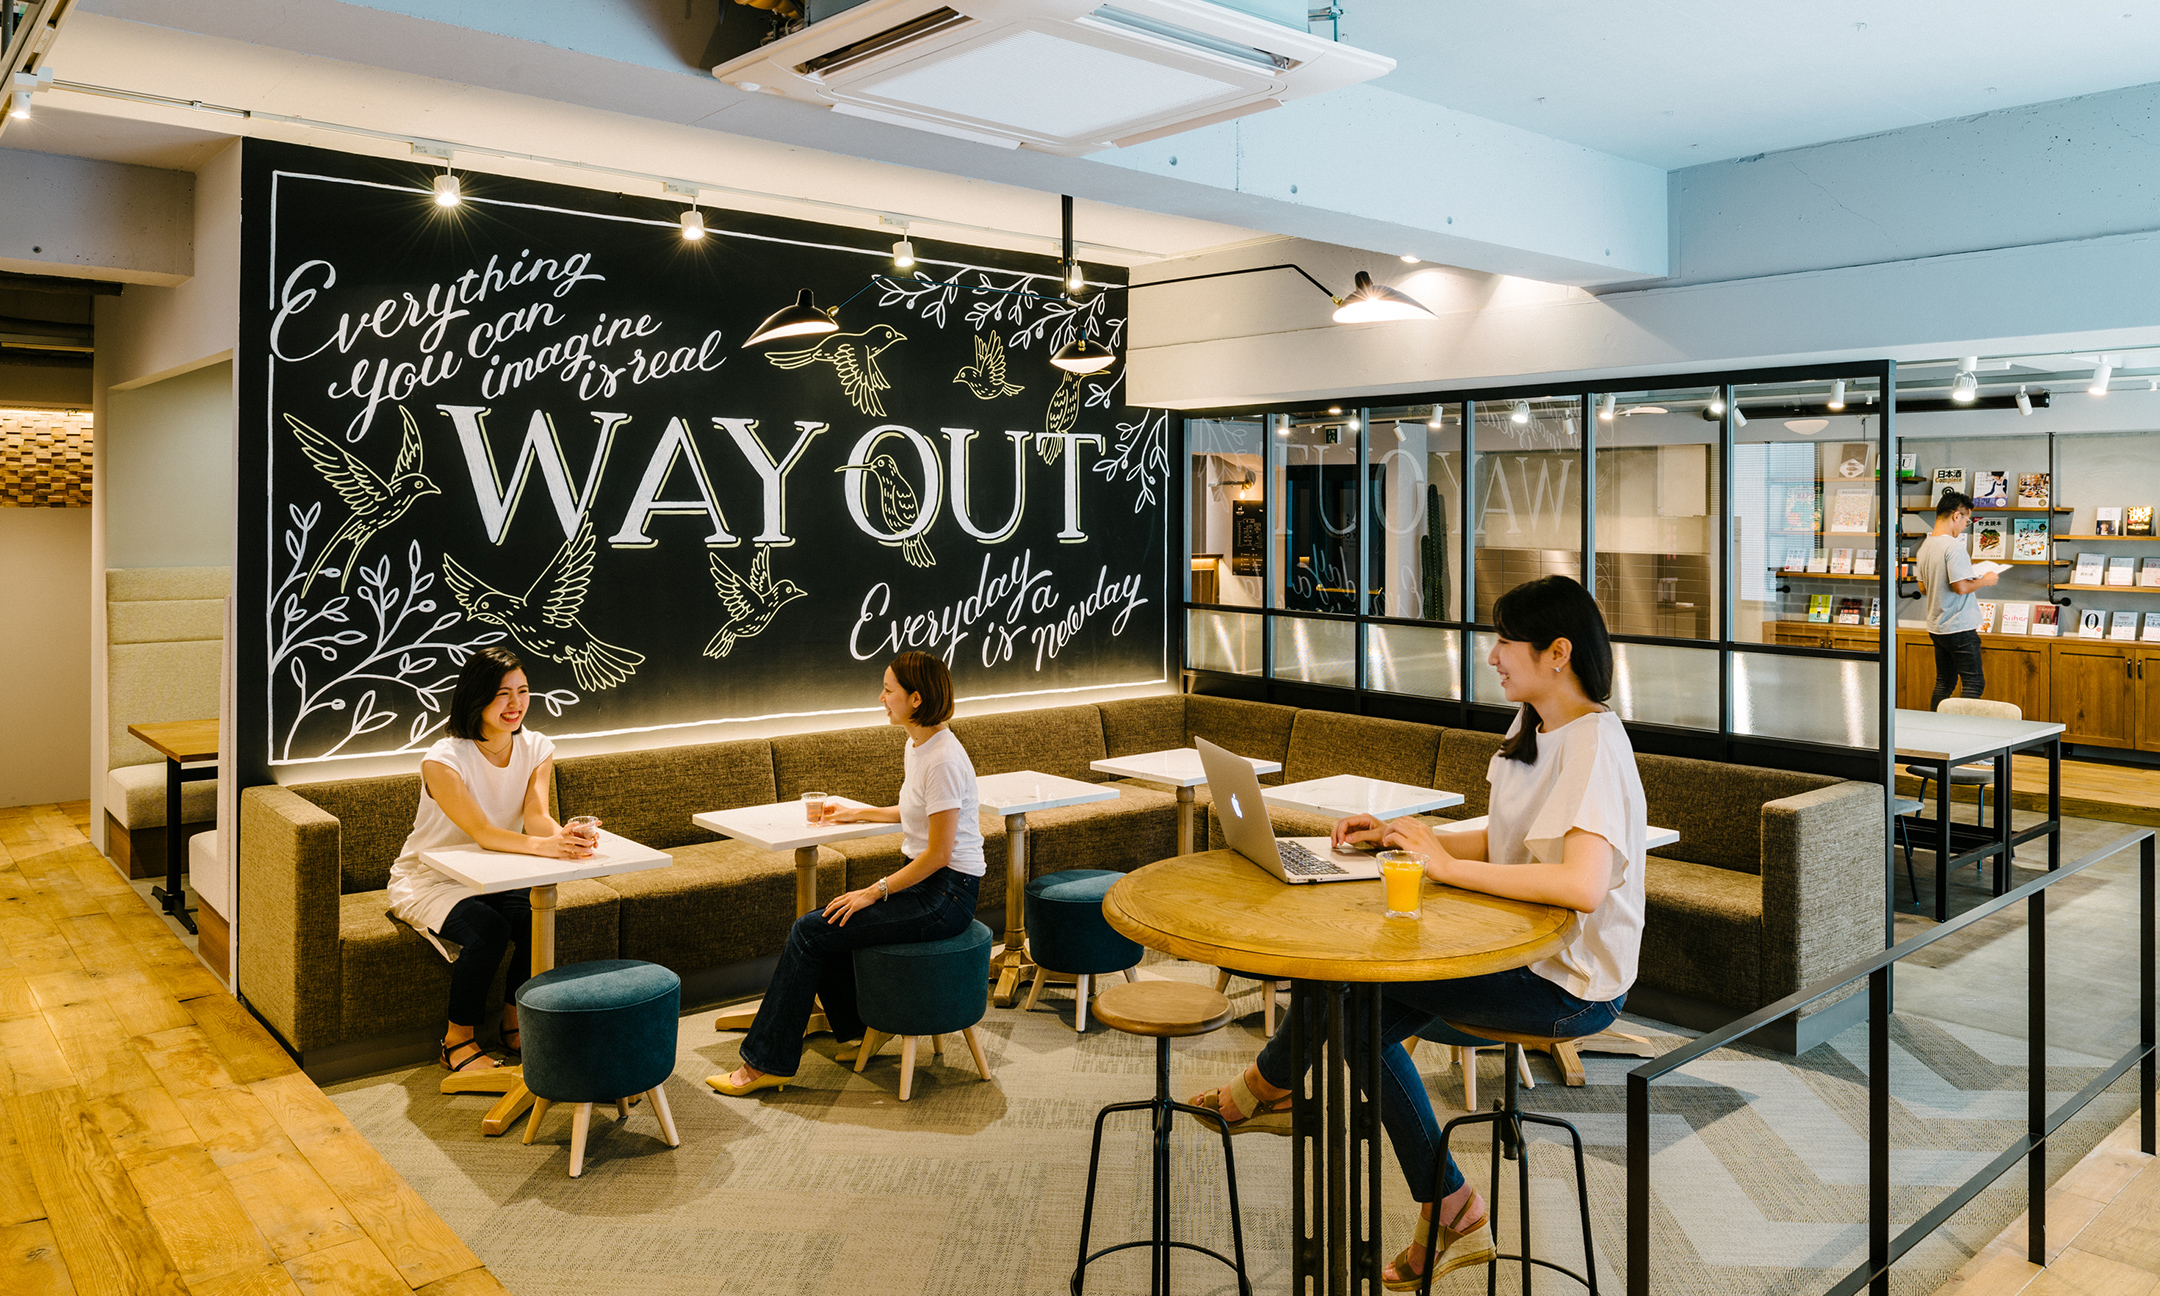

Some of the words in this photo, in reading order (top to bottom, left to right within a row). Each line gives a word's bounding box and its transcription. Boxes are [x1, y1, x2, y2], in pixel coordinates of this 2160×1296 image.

[270, 249, 605, 362] Everything
[328, 351, 463, 443] you
[468, 302, 565, 358] can
[481, 314, 663, 400] imagine
[579, 360, 625, 401] is
[626, 330, 727, 387] real
[436, 404, 829, 548] WAY
[844, 424, 1106, 547] OUT
[1938, 470, 1962, 478] 日本酒
[850, 549, 1053, 670] Everyday
[982, 622, 1027, 668] is
[1031, 585, 1060, 614] a
